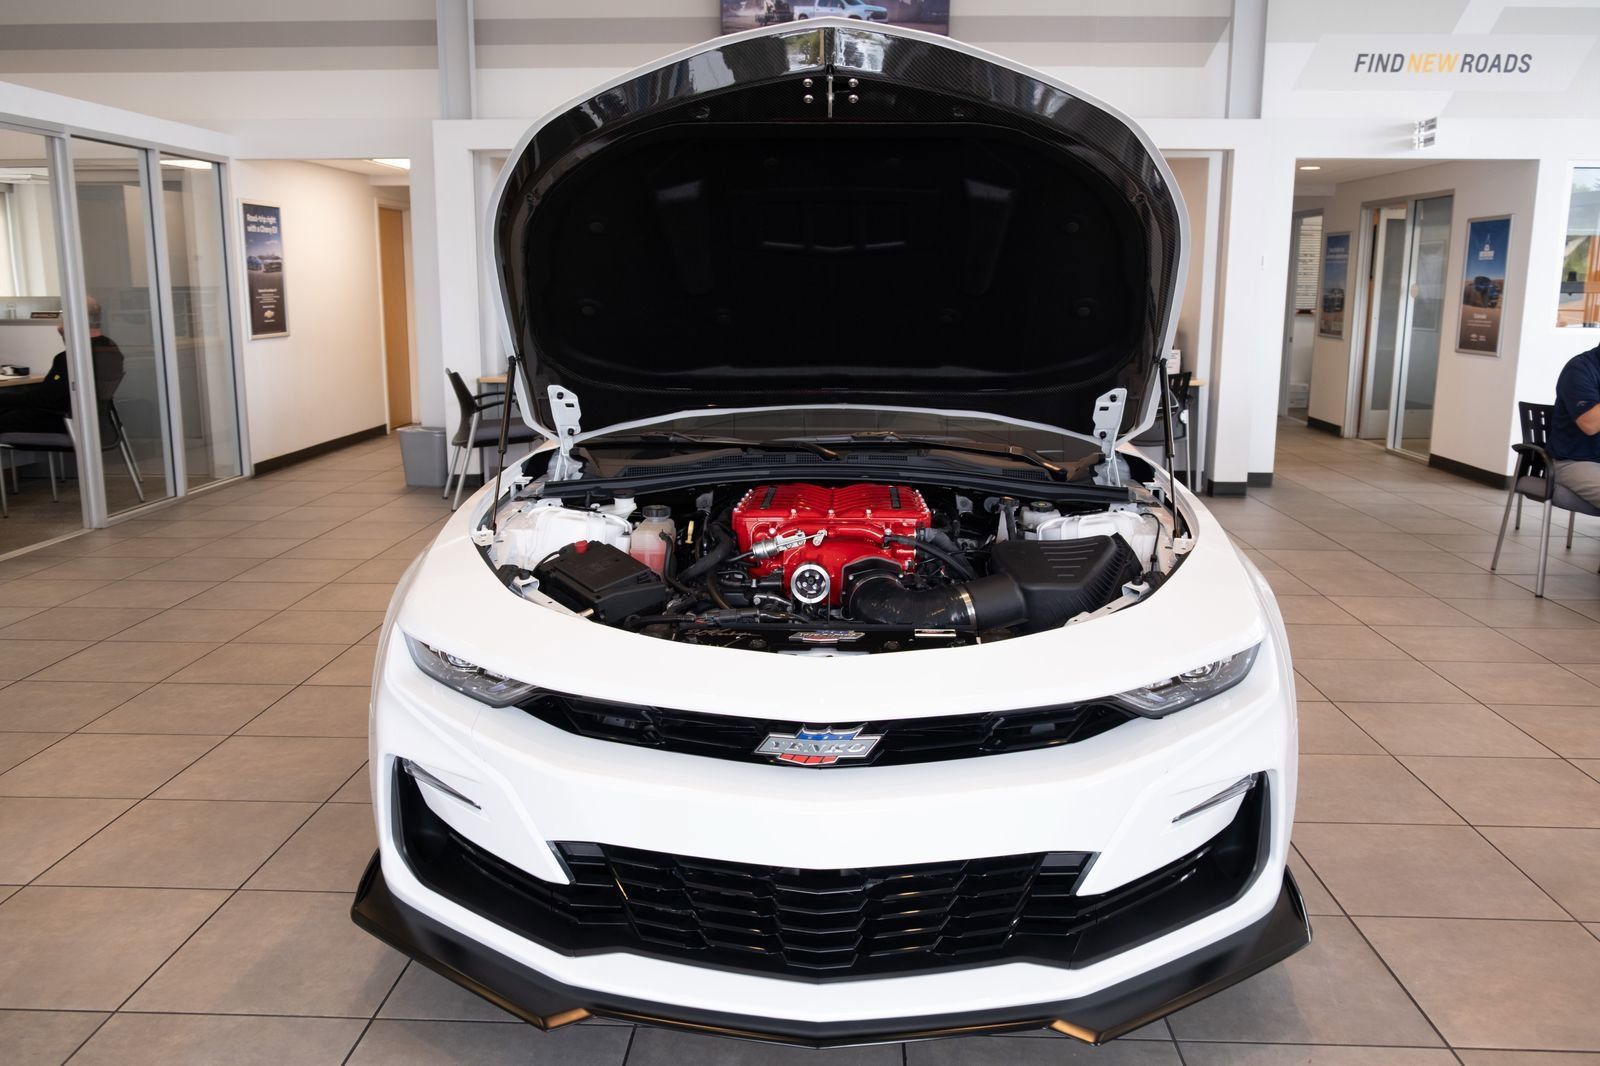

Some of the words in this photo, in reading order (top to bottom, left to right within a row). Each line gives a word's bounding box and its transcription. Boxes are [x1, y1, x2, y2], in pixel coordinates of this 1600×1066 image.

[1354, 53, 1404, 73] FIND
[1406, 53, 1460, 73] NEW
[1460, 53, 1533, 73] ROADS
